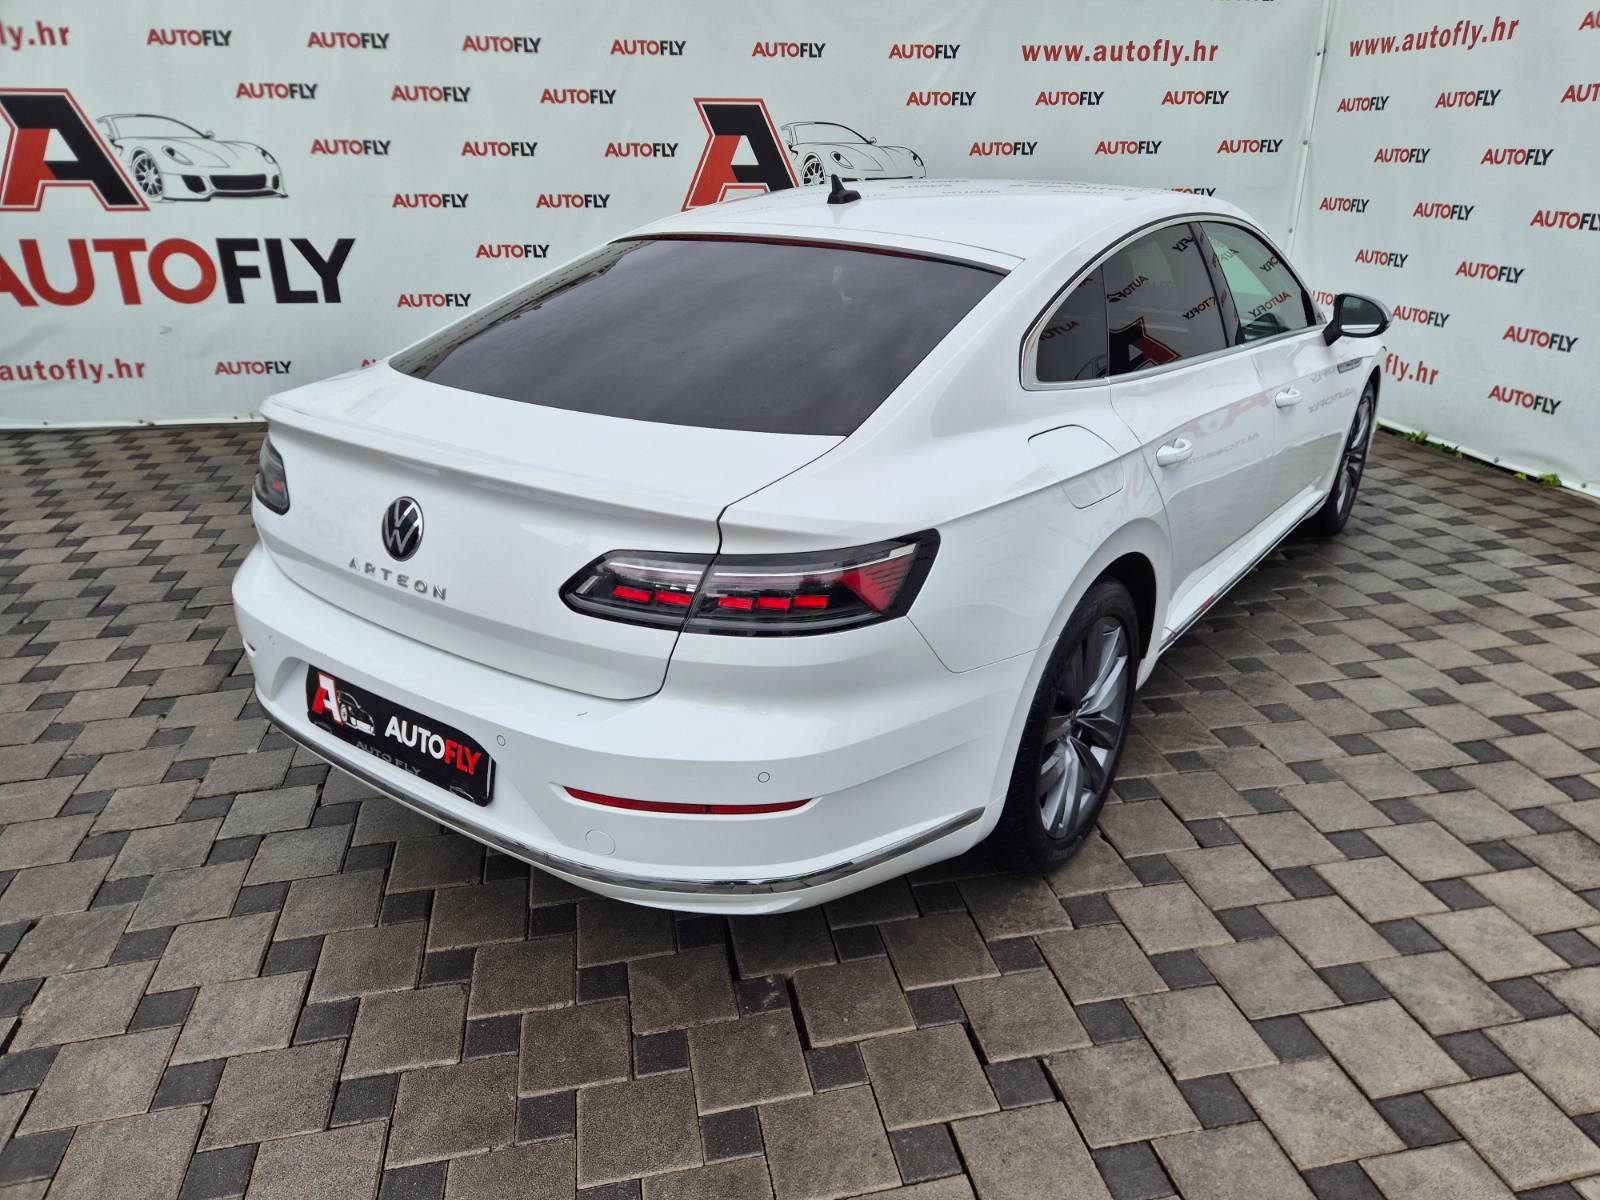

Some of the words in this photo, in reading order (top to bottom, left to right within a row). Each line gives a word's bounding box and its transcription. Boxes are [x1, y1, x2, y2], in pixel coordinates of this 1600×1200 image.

[147, 29, 232, 46] AUTOFLY
[308, 32, 389, 49] AUTOFLY
[463, 36, 541, 53] AUTOFLY
[1350, 16, 1519, 57] www.autofly.hr
[611, 40, 686, 55] AUTOFLY
[752, 42, 826, 58] AUTOFLY
[889, 44, 960, 59] AUTOFLY
[1022, 39, 1218, 66] www.autofly.hr
[236, 83, 317, 99] AUTOFLY
[391, 86, 470, 102] AUTOFLY
[541, 89, 616, 104] AUTOFLY
[906, 92, 976, 106] AUTOFLY
[1035, 92, 1104, 105] AUTOFLY
[1162, 91, 1229, 105] AUTOFLY
[1435, 89, 1501, 108] AUTOFLY
[1337, 96, 1389, 112] AUTOFLY
[311, 139, 390, 155] AUTOFLY
[462, 142, 538, 156] AUTOFLY
[605, 143, 678, 157] AUTOFLY
[969, 142, 1037, 156] AUTOFLY
[1095, 141, 1162, 155] AUTOFLY
[1217, 139, 1283, 153] AUTOFLY
[1374, 148, 1430, 163] AUTOFLY
[1480, 149, 1554, 165] AUTOFLY
[392, 194, 468, 208] AUTOFLY
[536, 194, 610, 208] AUTOFLY
[1320, 197, 1369, 213] AUTOFLY
[1413, 203, 1474, 221] AUTOFLY
[1530, 210, 1600, 231] AUTOFL
[476, 244, 550, 258] AUTOFLY
[1355, 249, 1408, 268] AUTOFLY
[1456, 261, 1524, 283] AUTOFLY
[397, 294, 471, 307] AUTOFLY
[1393, 306, 1450, 328] AUTOFLY
[1503, 326, 1578, 353] AUTOFLY
[215, 361, 291, 374] AUTOFLY
[1488, 385, 1561, 415] AUTOFLY
[349, 557, 447, 600] ARTEON
[384, 716, 482, 775] AUTOFLY
